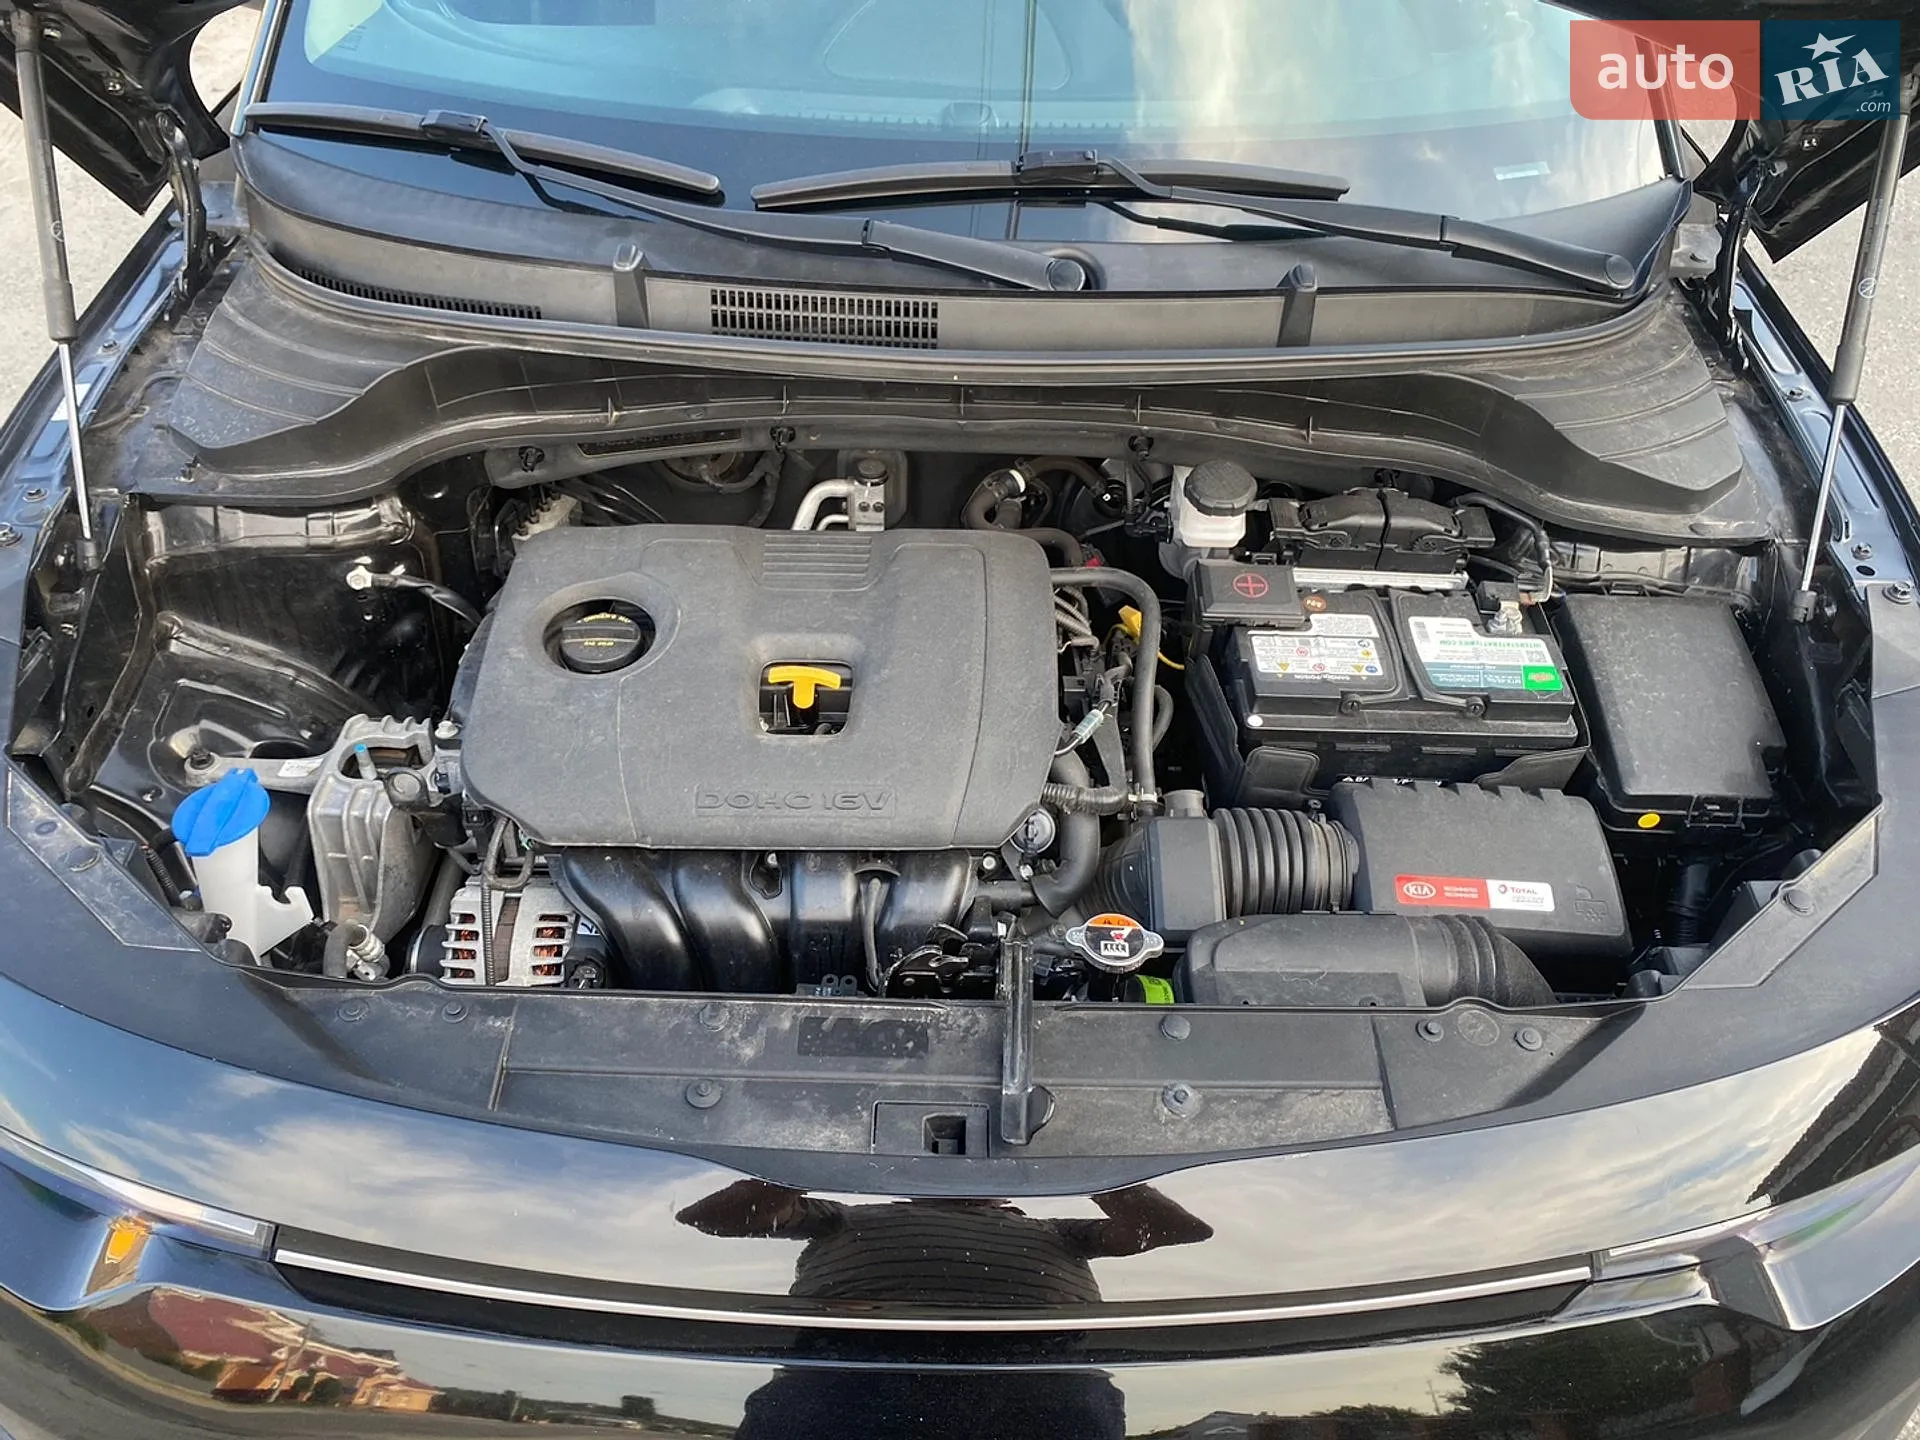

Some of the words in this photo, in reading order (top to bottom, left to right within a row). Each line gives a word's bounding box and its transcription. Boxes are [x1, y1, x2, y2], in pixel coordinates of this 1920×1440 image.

[695, 790, 815, 811] DOHC
[823, 790, 893, 811] 16V
[1407, 883, 1432, 896] KIA
[1509, 886, 1539, 895] TOTAL
